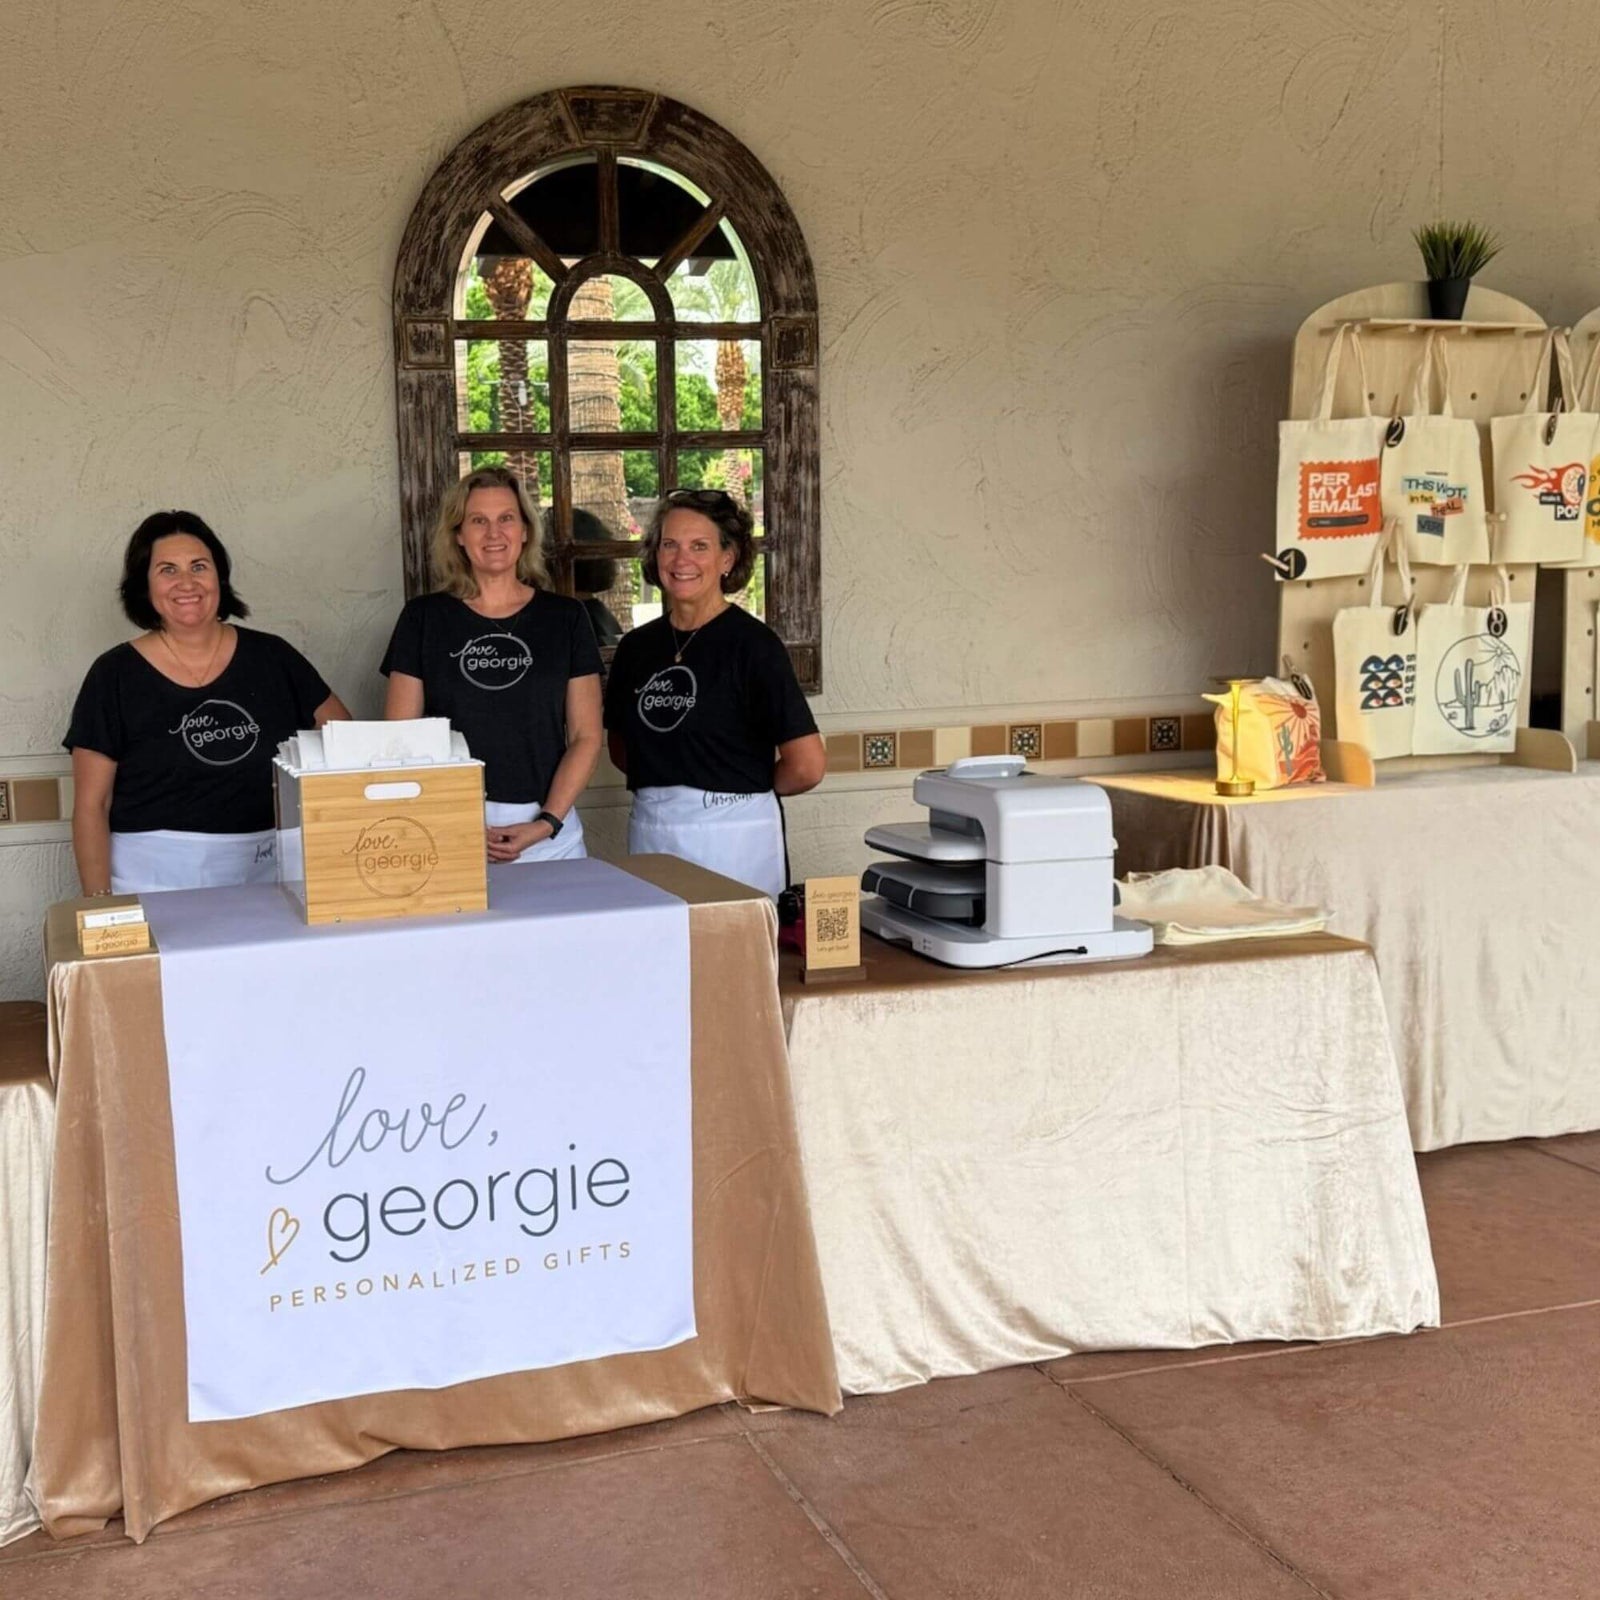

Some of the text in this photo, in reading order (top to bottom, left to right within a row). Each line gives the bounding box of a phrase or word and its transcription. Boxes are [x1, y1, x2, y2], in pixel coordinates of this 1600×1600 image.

[1387, 417, 1404, 446] 2
[1308, 472, 1350, 486] PER
[1308, 482, 1377, 500] MY LAST
[1308, 498, 1363, 514] EMAIL
[1283, 550, 1296, 578] 1
[1490, 610, 1505, 636] 8
[466, 653, 533, 671] georgie
[643, 692, 697, 711] georgie
[190, 720, 261, 748] georgie
[364, 852, 439, 875] georgie
[322, 1142, 631, 1264] georgie
[269, 1241, 632, 1312] PERSONALIZED GIFTS
